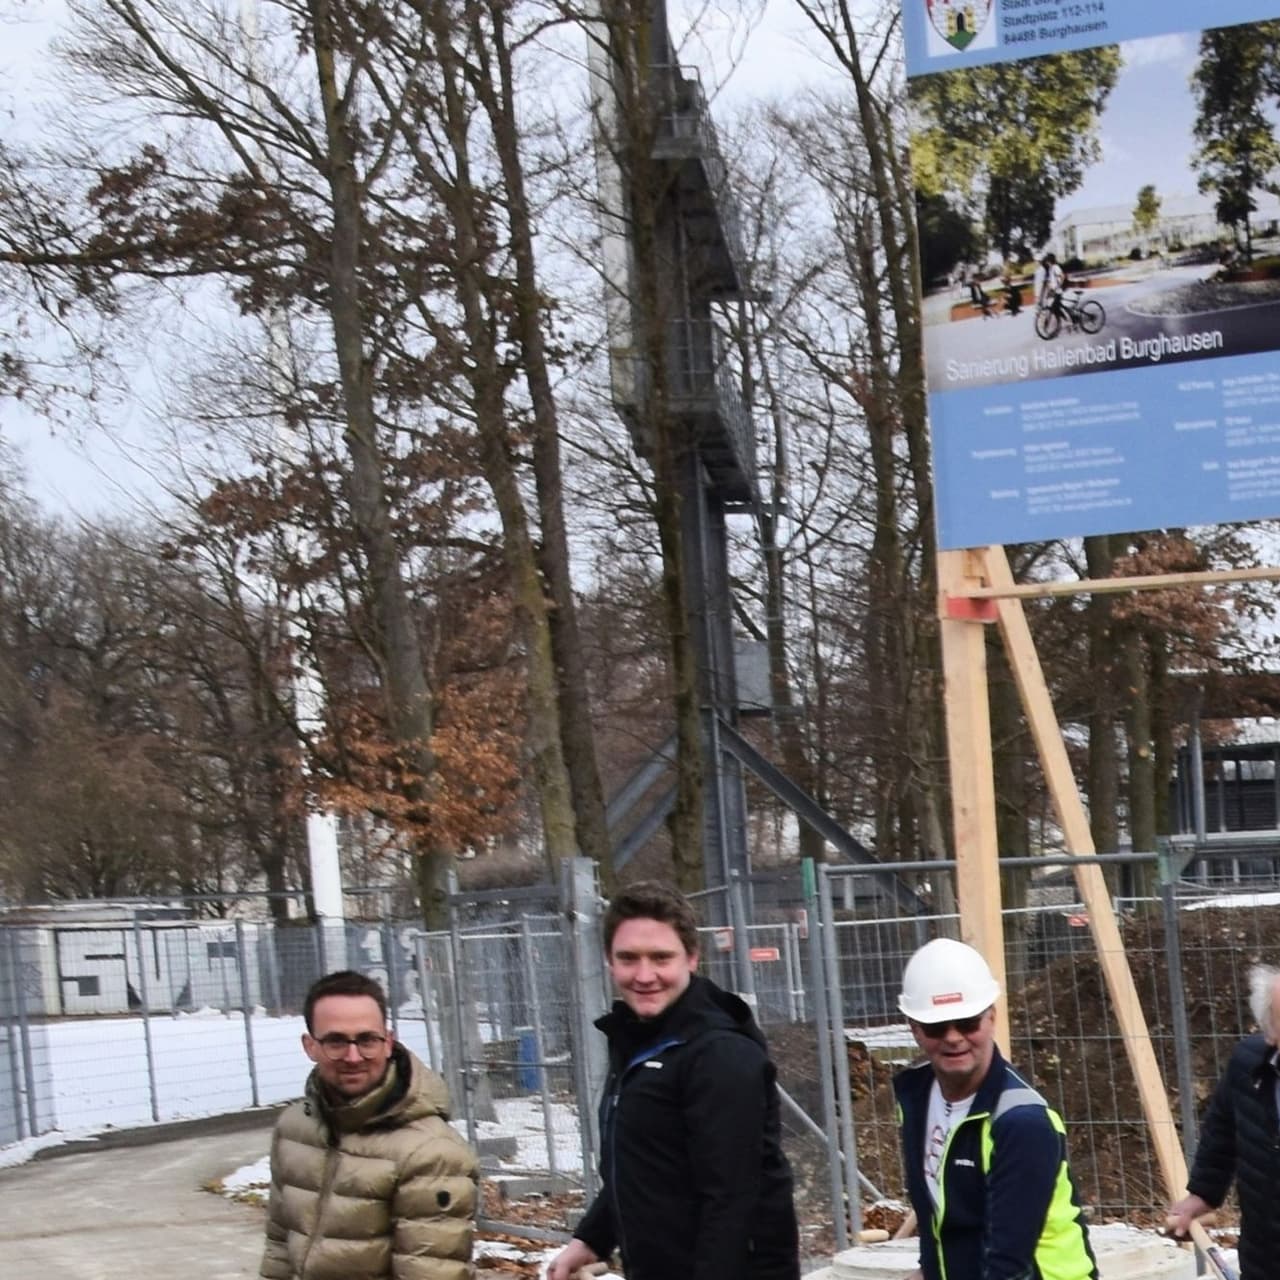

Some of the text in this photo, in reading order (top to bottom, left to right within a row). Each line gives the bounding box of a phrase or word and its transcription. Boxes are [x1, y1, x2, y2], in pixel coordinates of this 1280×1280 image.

[1039, 21, 1108, 39] Burghausen
[946, 330, 1223, 381] Sanierung Hallenbad Burghausen
